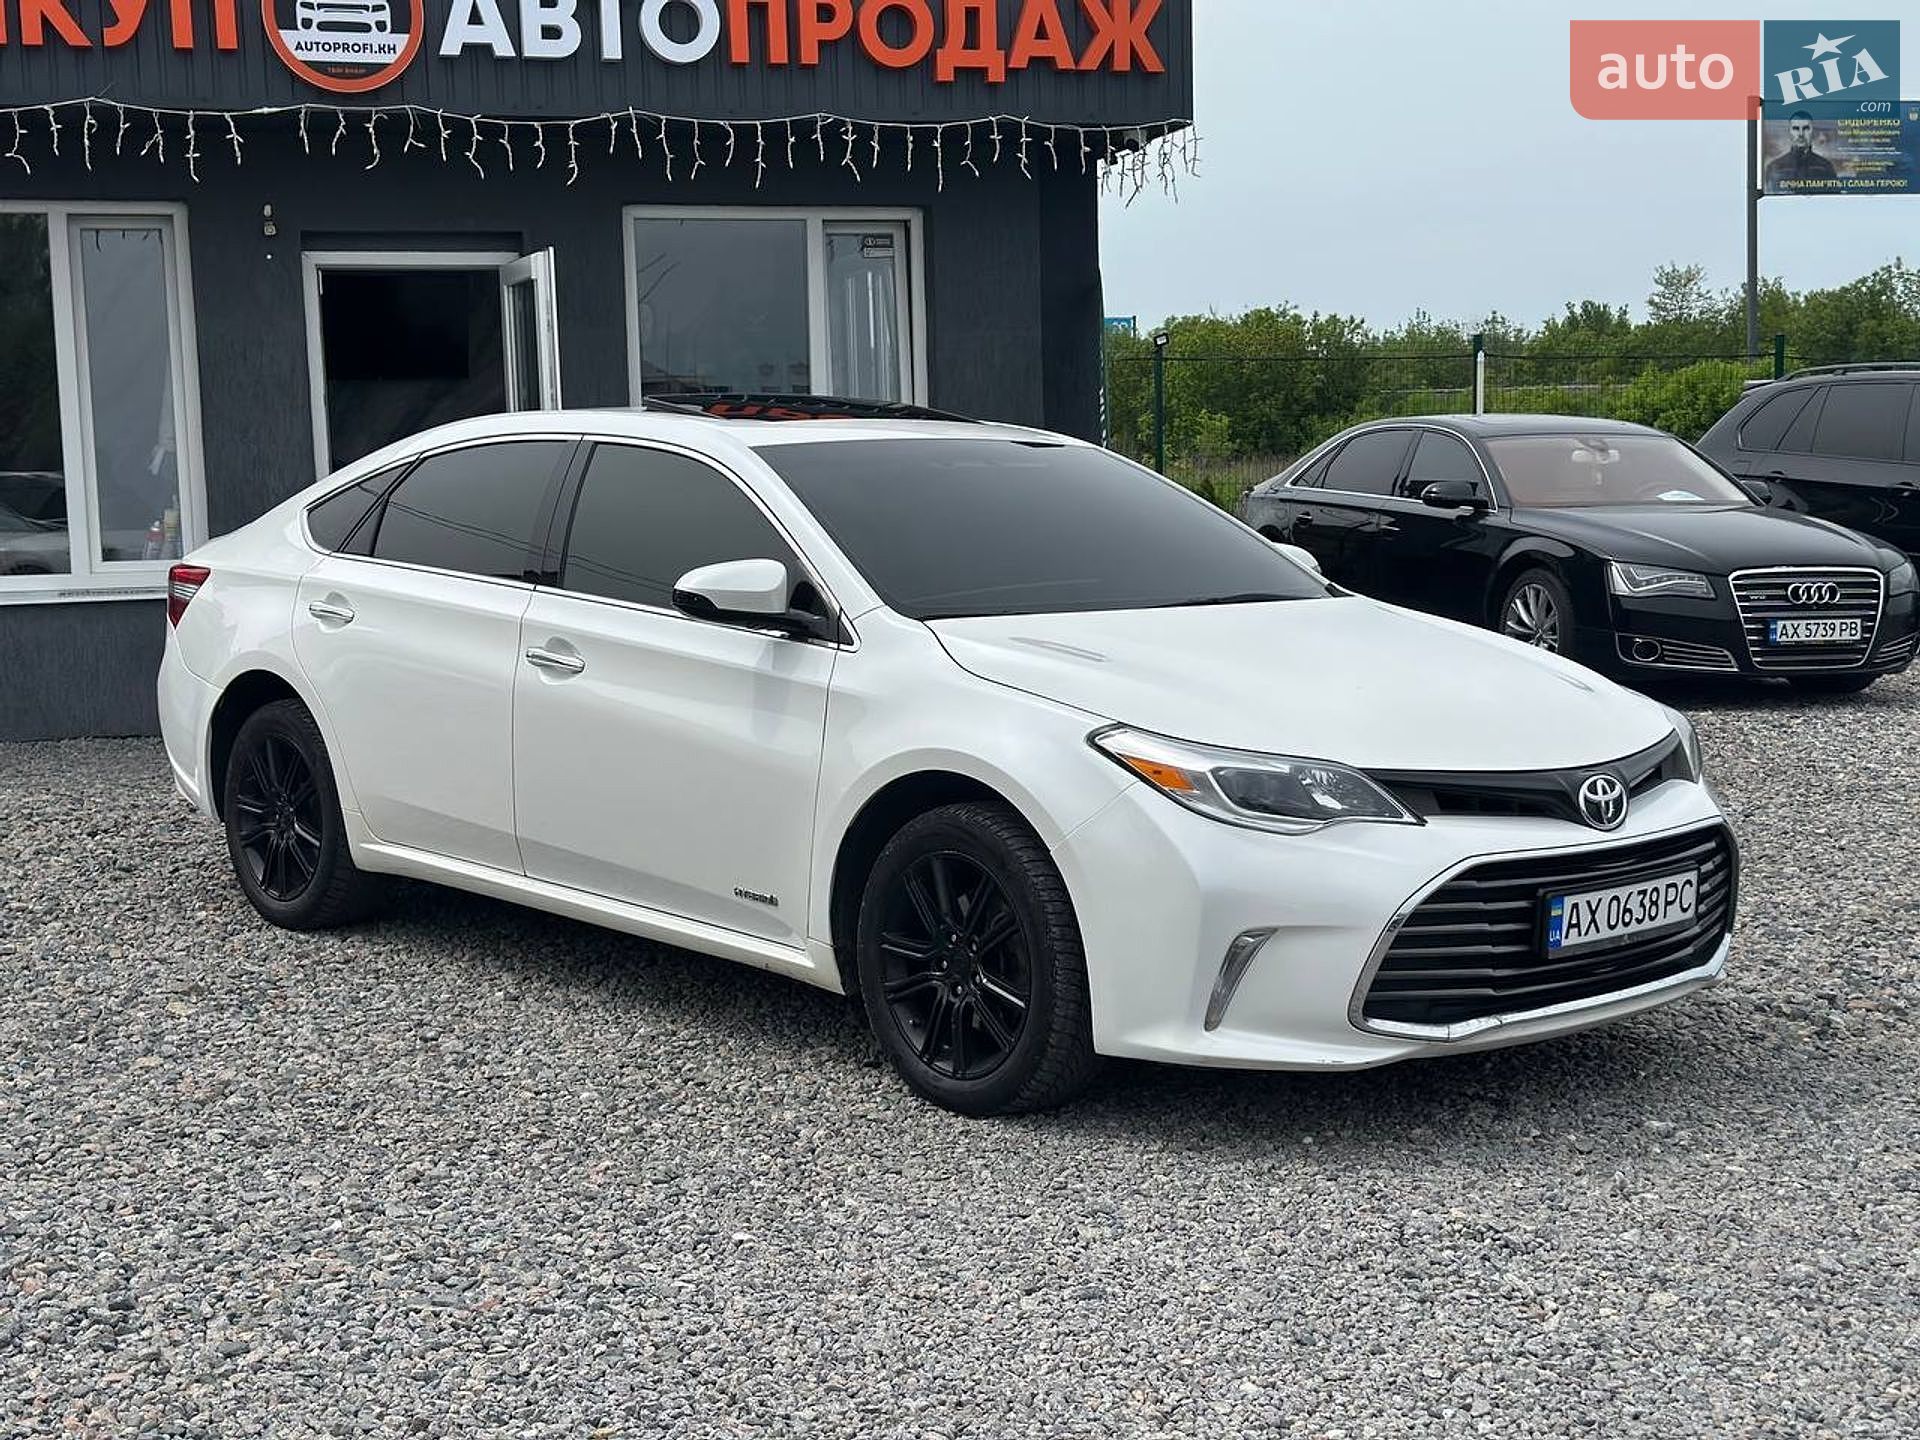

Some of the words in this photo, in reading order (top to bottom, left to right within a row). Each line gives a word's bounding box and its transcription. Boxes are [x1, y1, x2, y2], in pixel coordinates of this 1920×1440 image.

[294, 41, 397, 55] AUTOPROFI.KH
[1779, 623, 1801, 639] AX
[1804, 622, 1836, 638] 5739
[1839, 621, 1858, 637] PB
[1564, 897, 1603, 940] AX
[1606, 886, 1660, 931] 0638
[1663, 878, 1694, 919] PC
